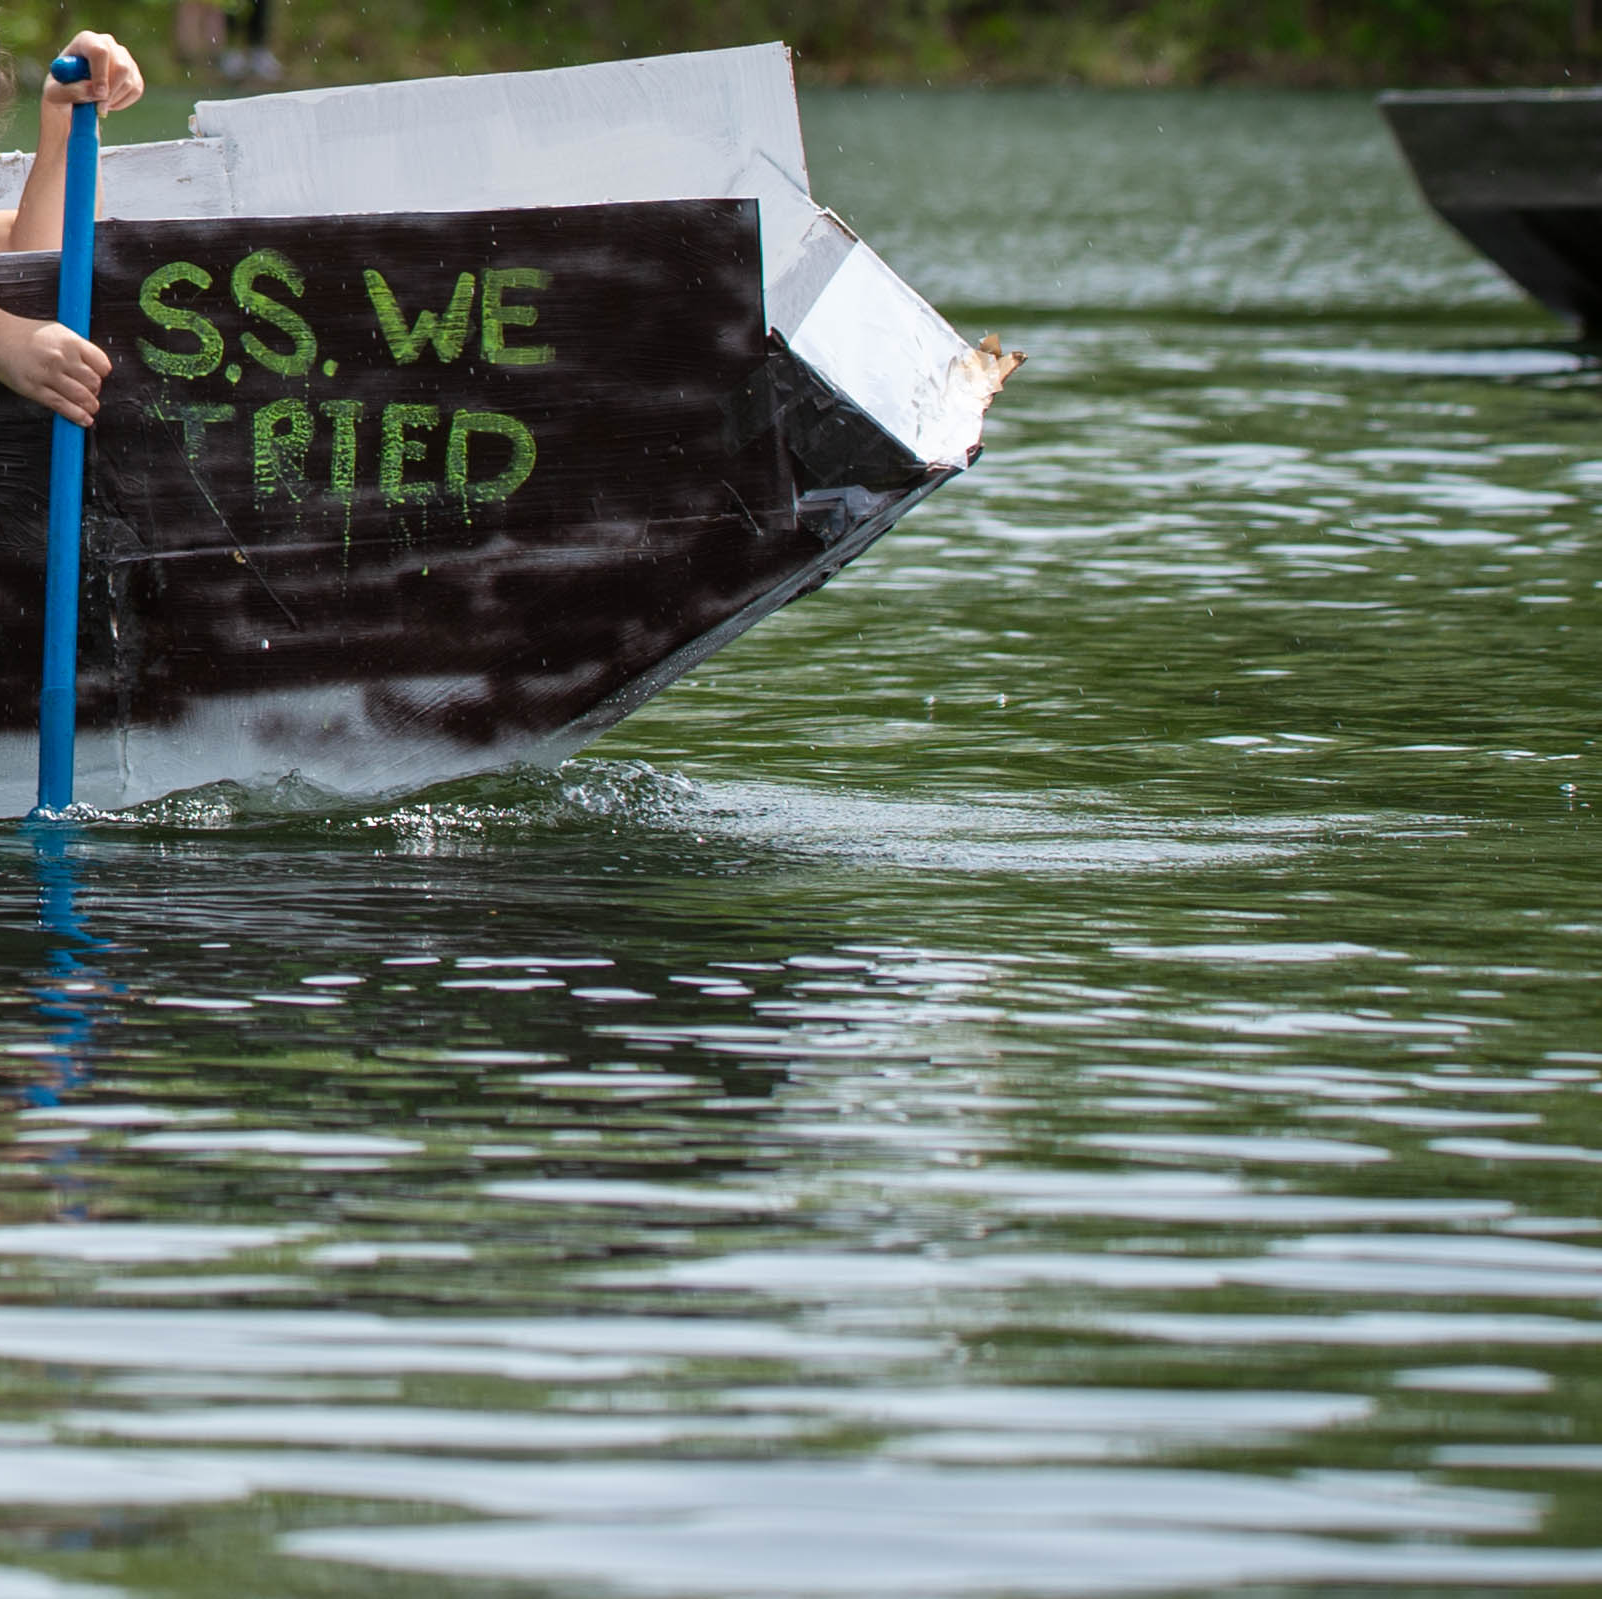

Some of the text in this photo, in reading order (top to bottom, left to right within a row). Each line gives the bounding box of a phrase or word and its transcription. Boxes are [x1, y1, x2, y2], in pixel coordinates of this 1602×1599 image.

[135, 248, 556, 386] S.S. WE
[144, 397, 538, 504] TRIED
